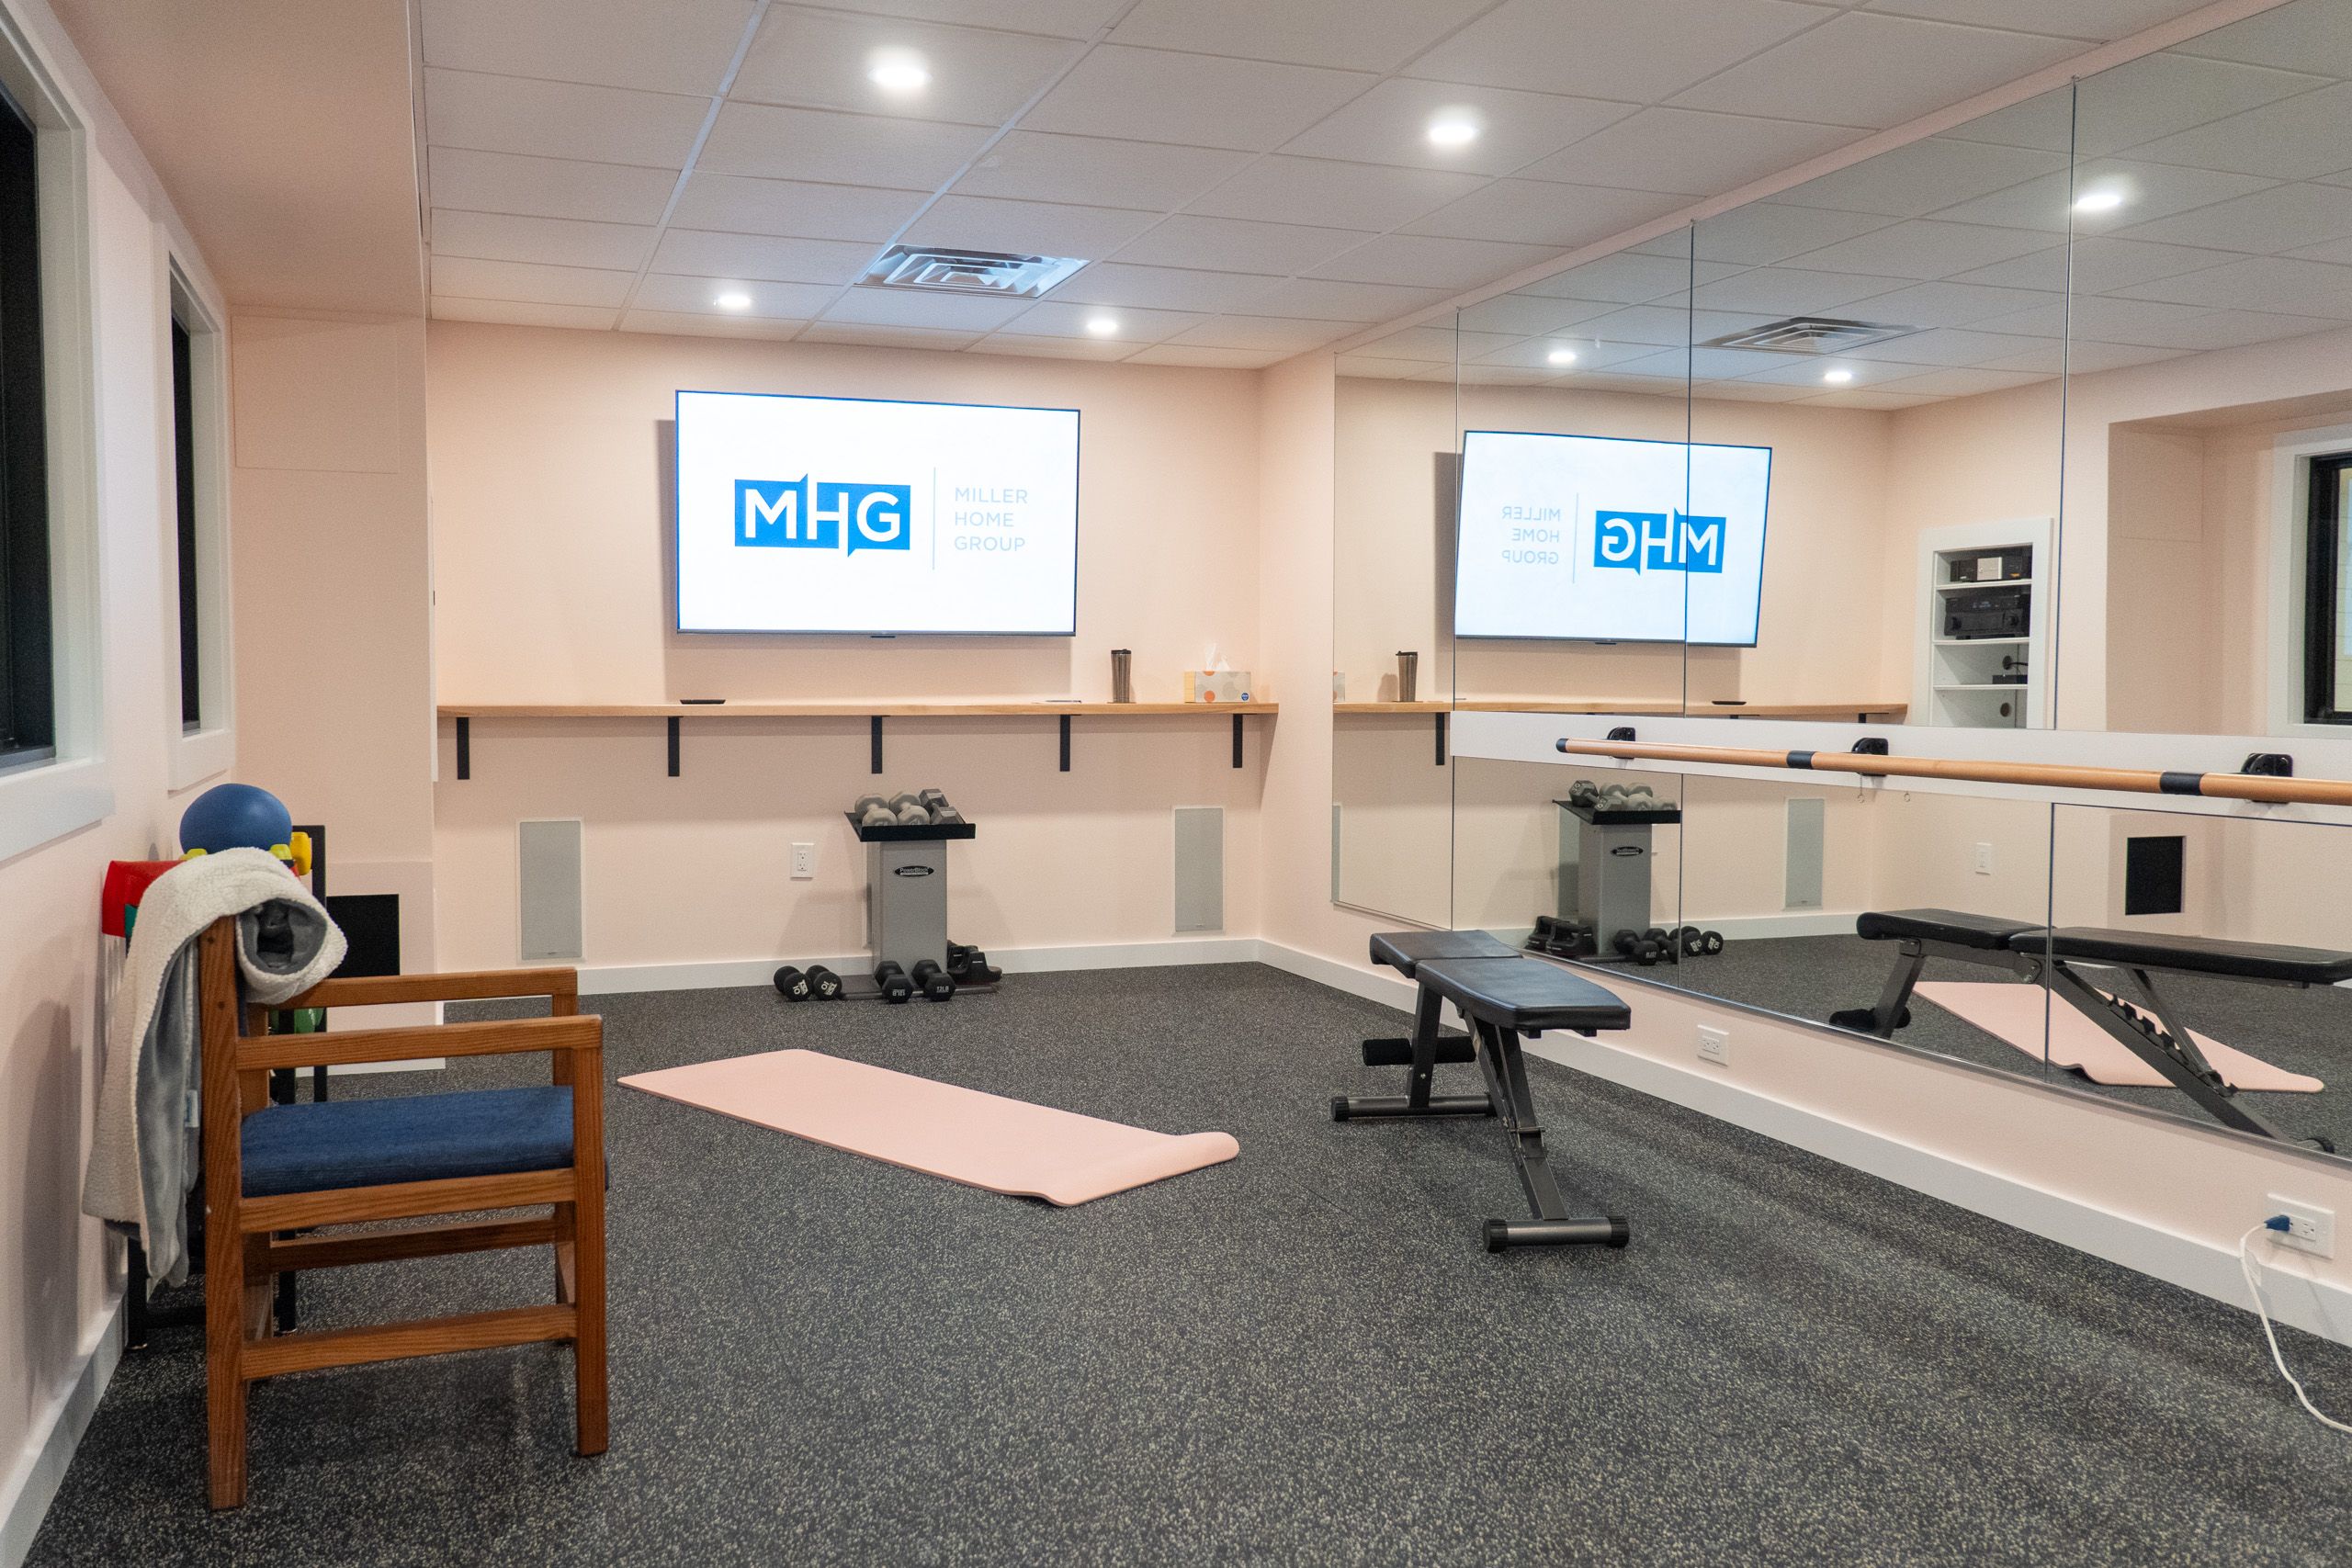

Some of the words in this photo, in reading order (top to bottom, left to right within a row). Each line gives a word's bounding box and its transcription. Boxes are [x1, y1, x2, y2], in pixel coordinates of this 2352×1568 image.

[955, 487, 1028, 504] MILLER
[742, 474, 902, 557] MHG
[955, 511, 1015, 527] HOME
[954, 535, 1026, 552] GROUP
[793, 985, 801, 995] 10
[820, 980, 830, 990] 10
